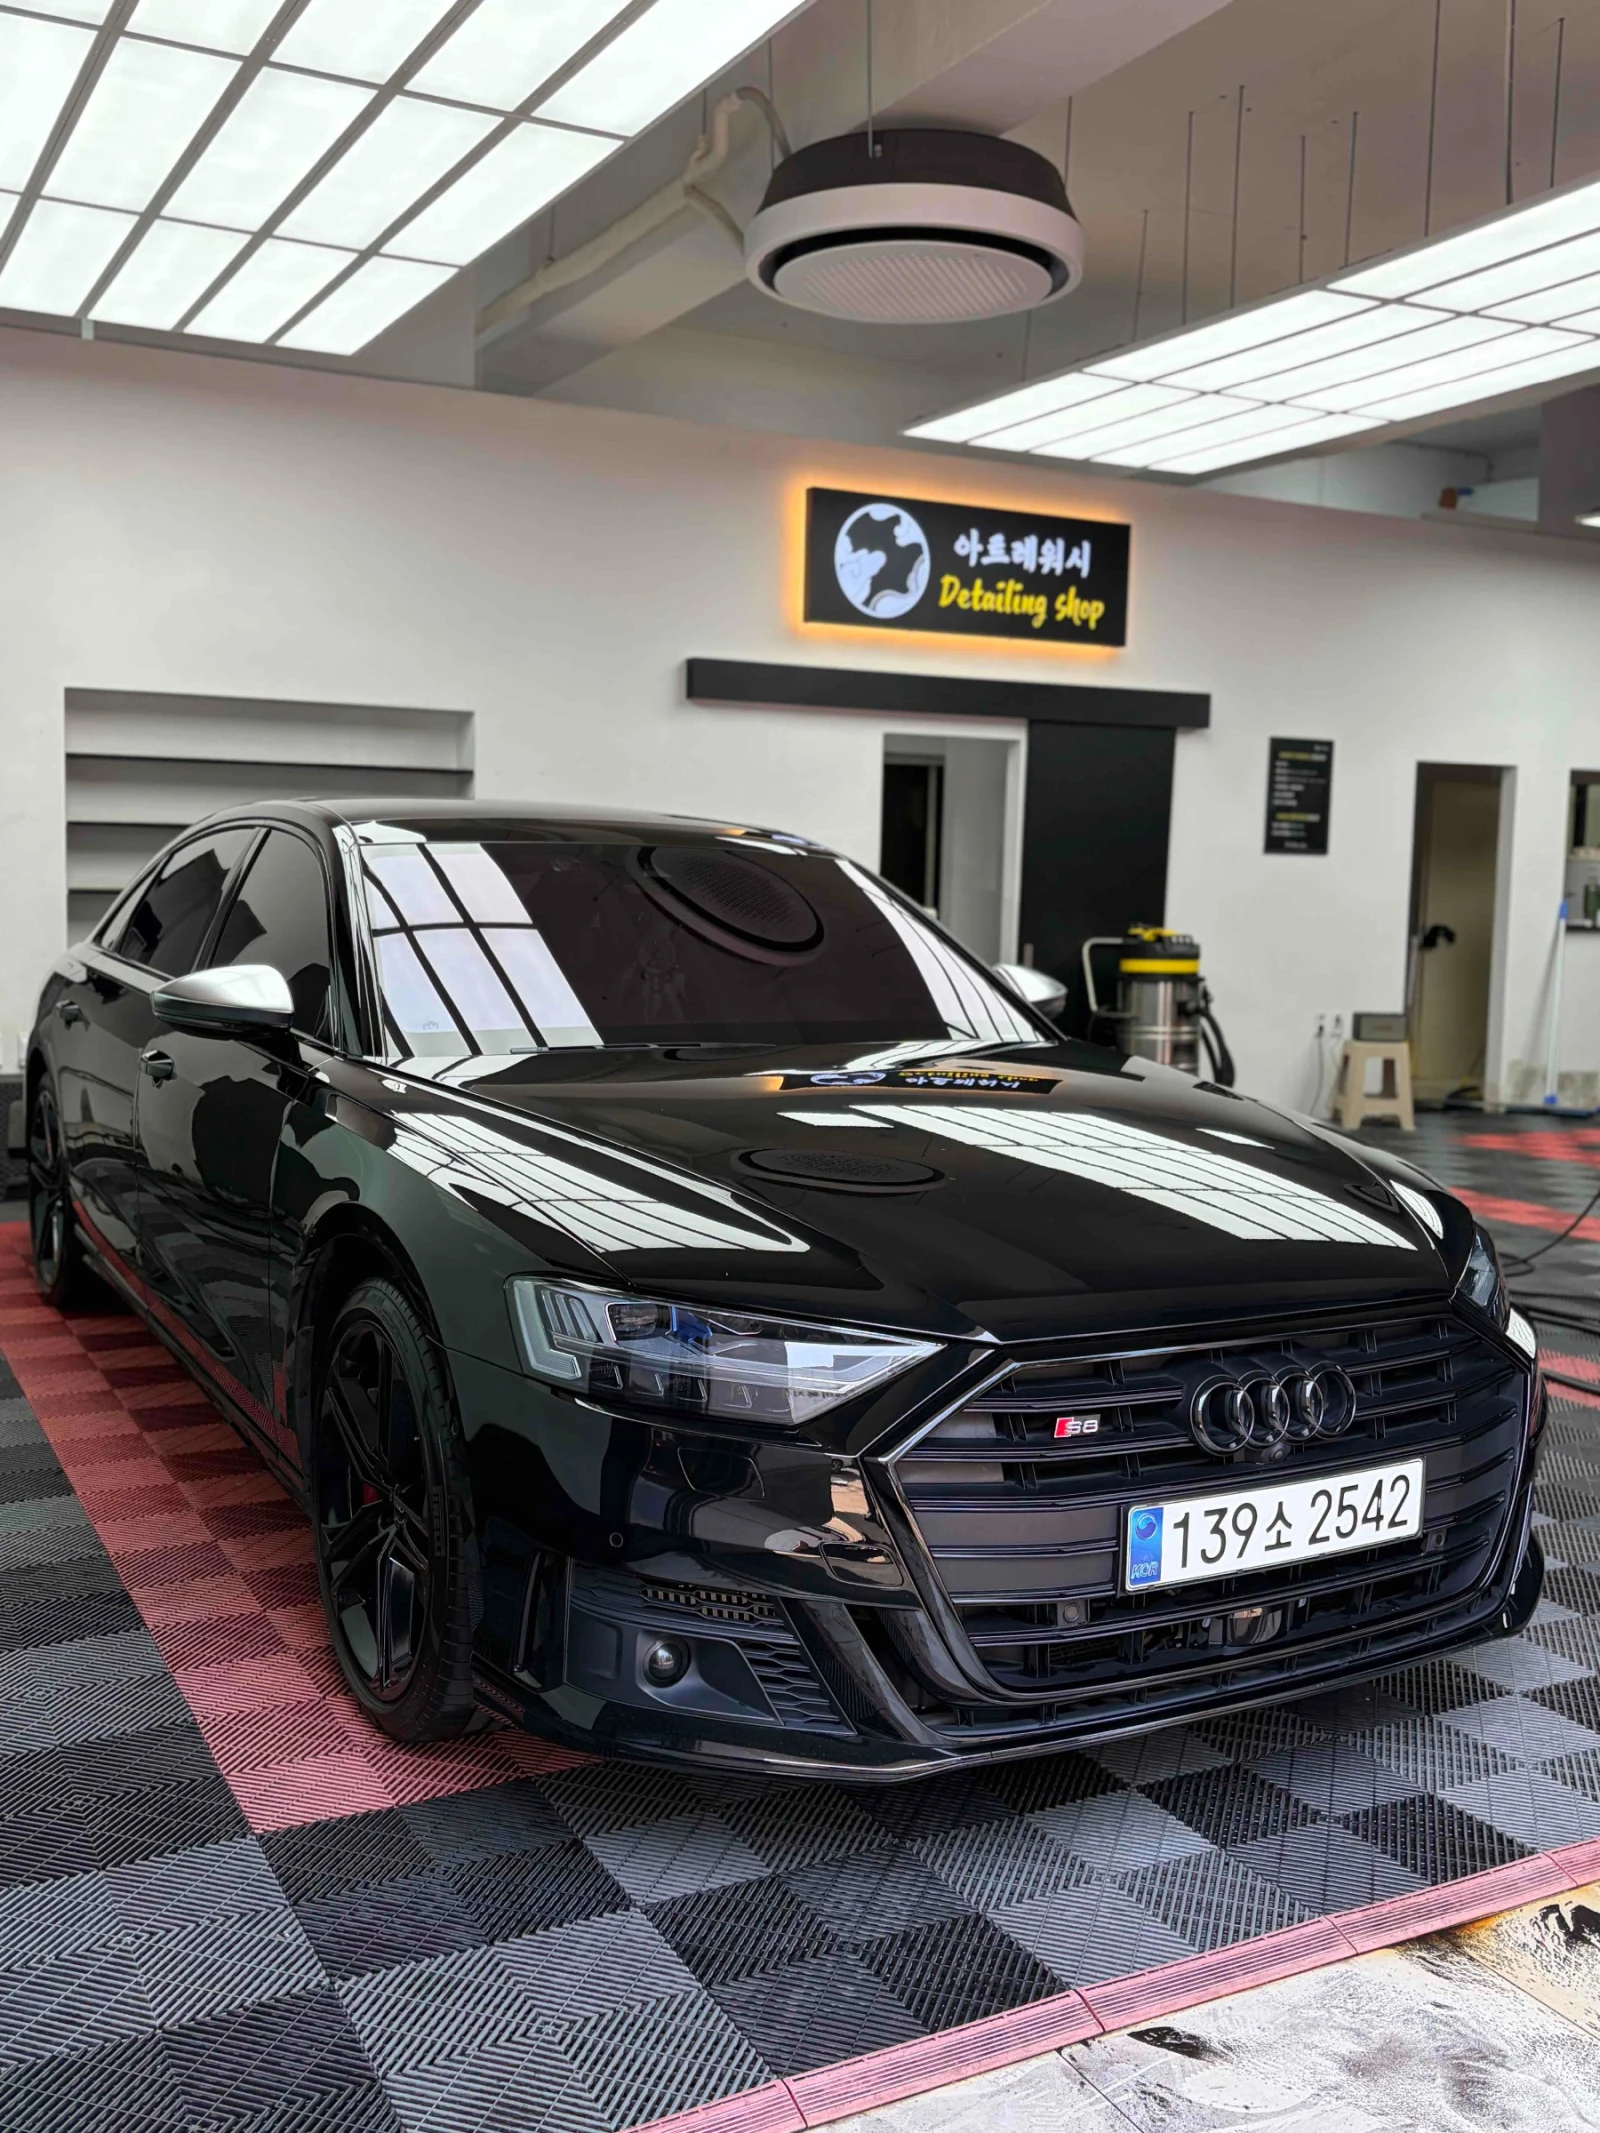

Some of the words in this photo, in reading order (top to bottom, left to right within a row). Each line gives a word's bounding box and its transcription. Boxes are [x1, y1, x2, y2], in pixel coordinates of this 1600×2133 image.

[953, 528, 1092, 579] 아트레워시
[938, 574, 1049, 630] Detailing
[1054, 585, 1105, 631] shop
[1065, 1419, 1099, 1435] S8
[1172, 1500, 1293, 1569] 139소
[1307, 1474, 1411, 1546] 2542
[1130, 1560, 1159, 1580] KOR
